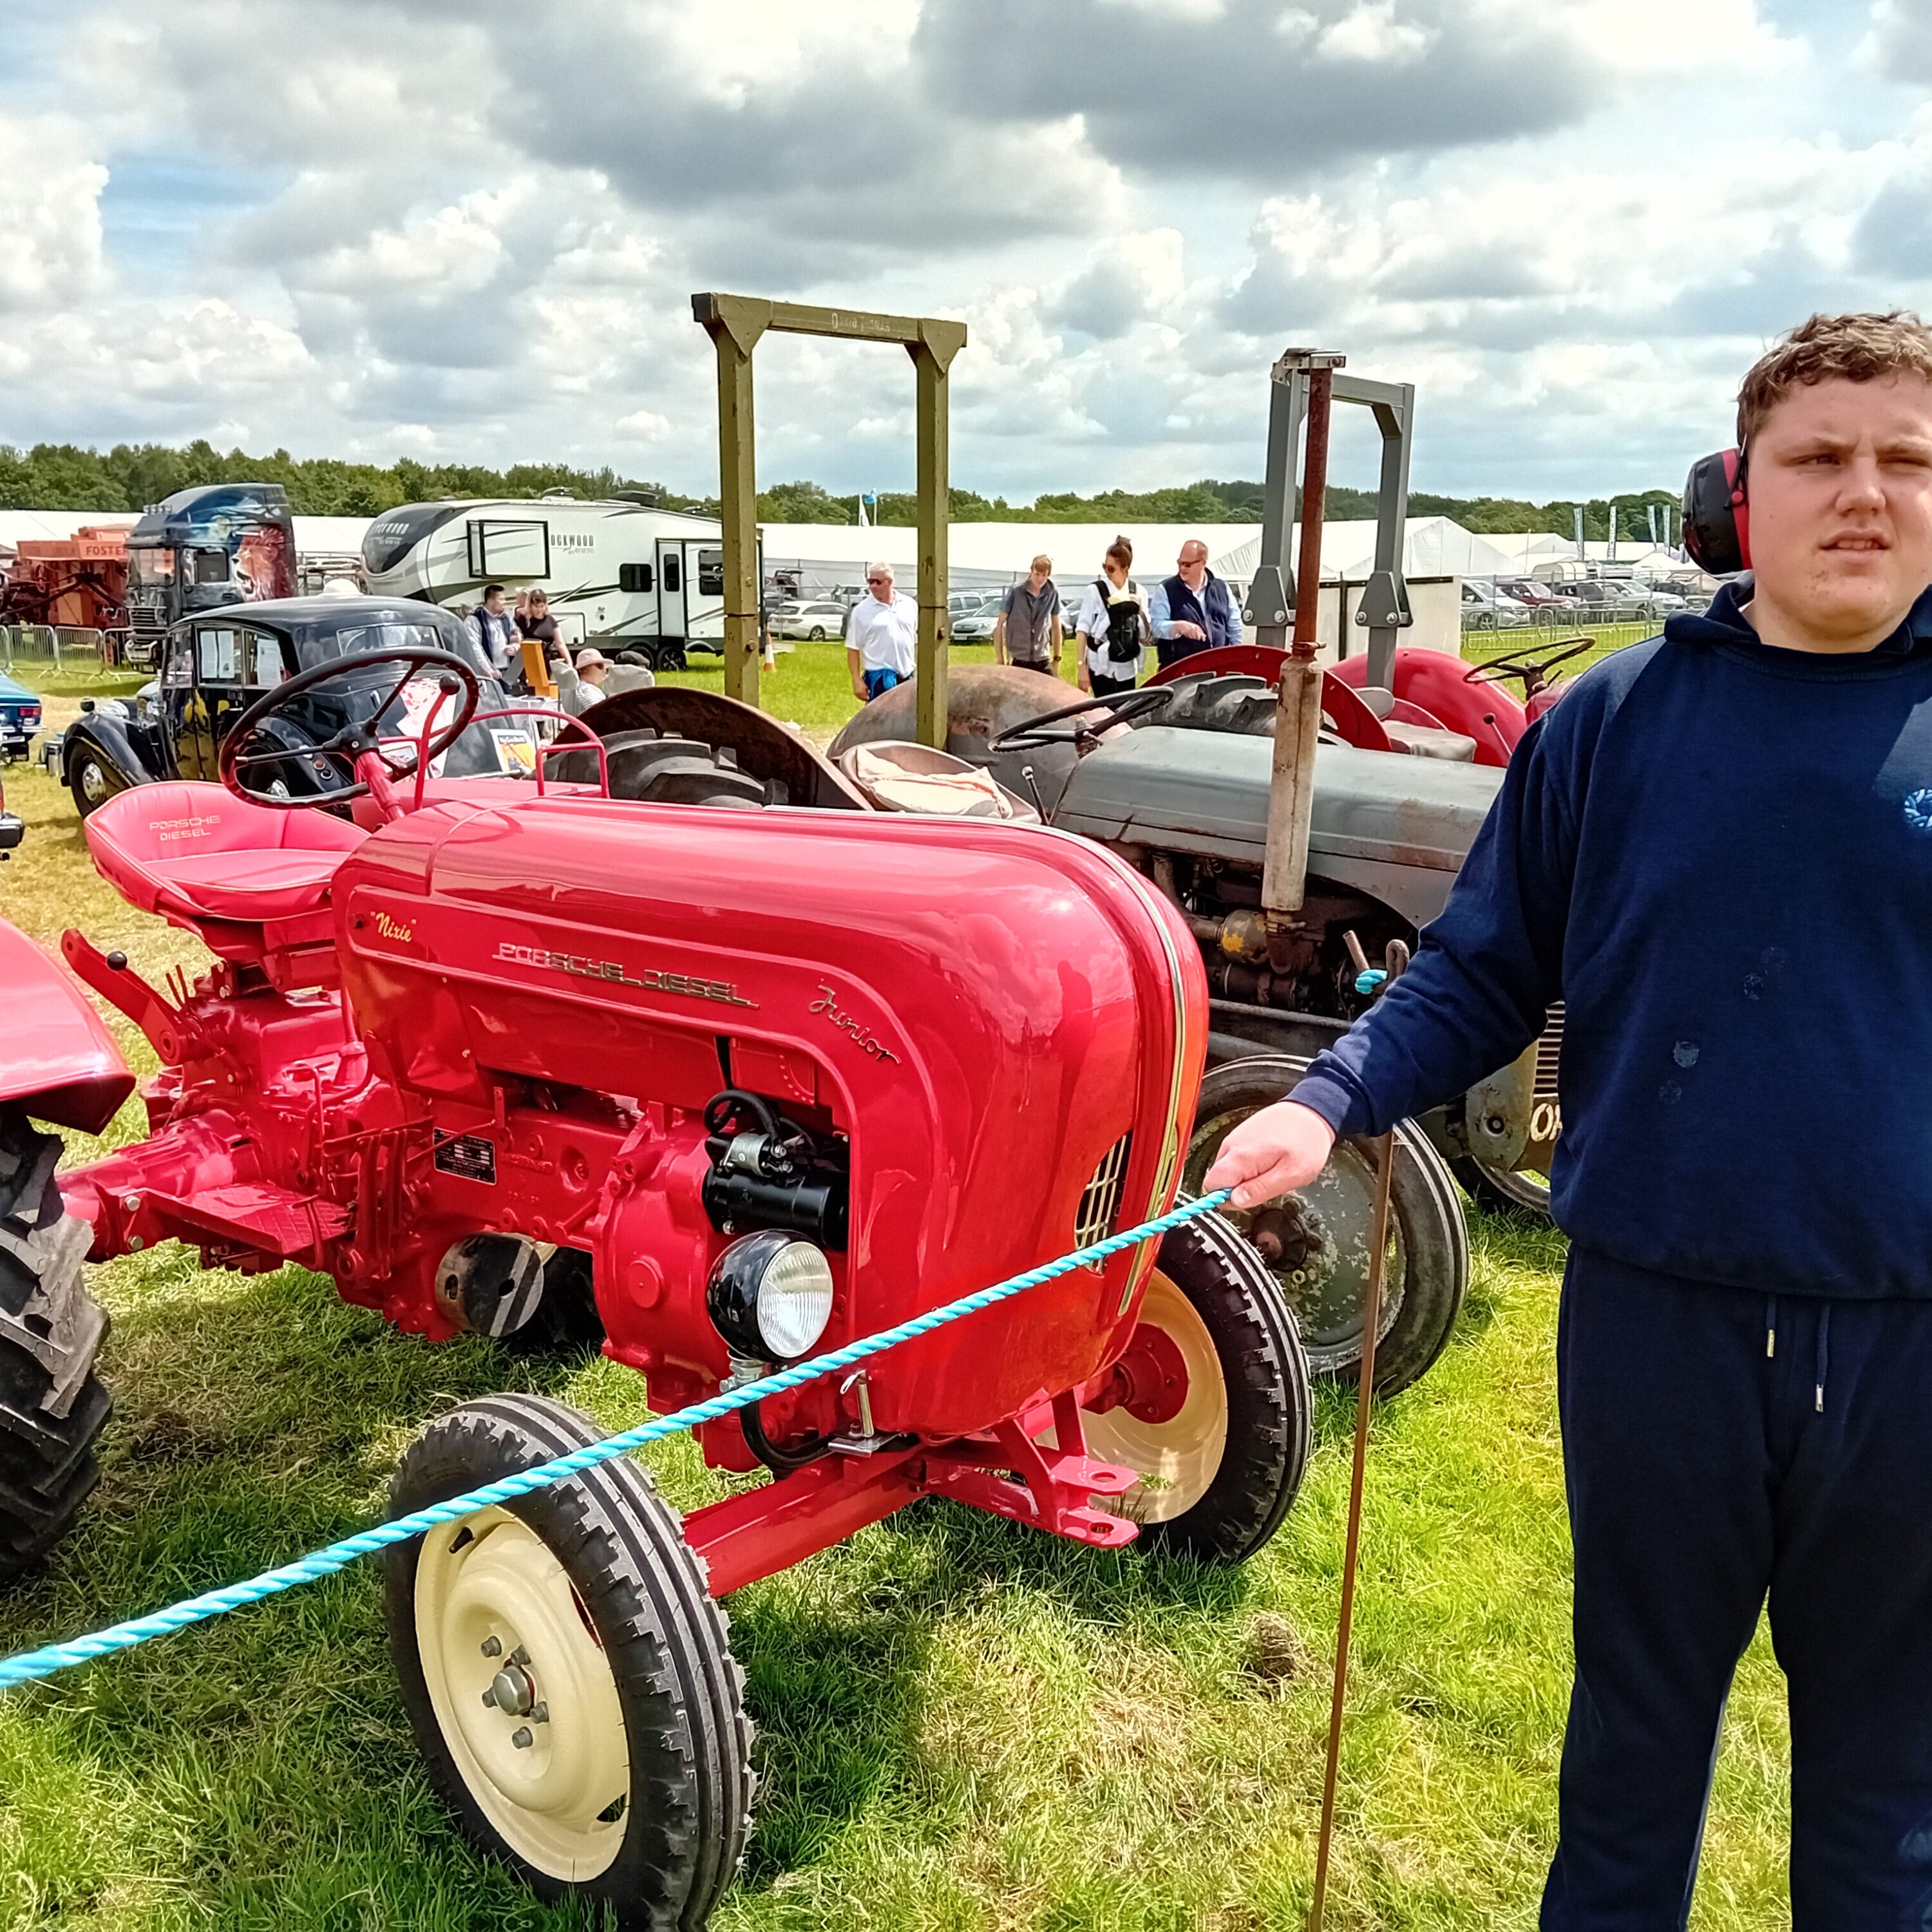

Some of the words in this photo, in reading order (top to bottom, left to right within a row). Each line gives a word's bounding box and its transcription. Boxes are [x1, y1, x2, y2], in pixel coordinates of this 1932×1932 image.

[551, 534, 594, 547] OCKWOOD
[149, 815, 221, 831] PORSCHE
[159, 828, 211, 842] DIESEL
[370, 911, 417, 942] "Nixie"
[492, 942, 625, 982] PORSCHE
[643, 969, 761, 1009] DIESEL
[808, 985, 902, 1065] Junior
